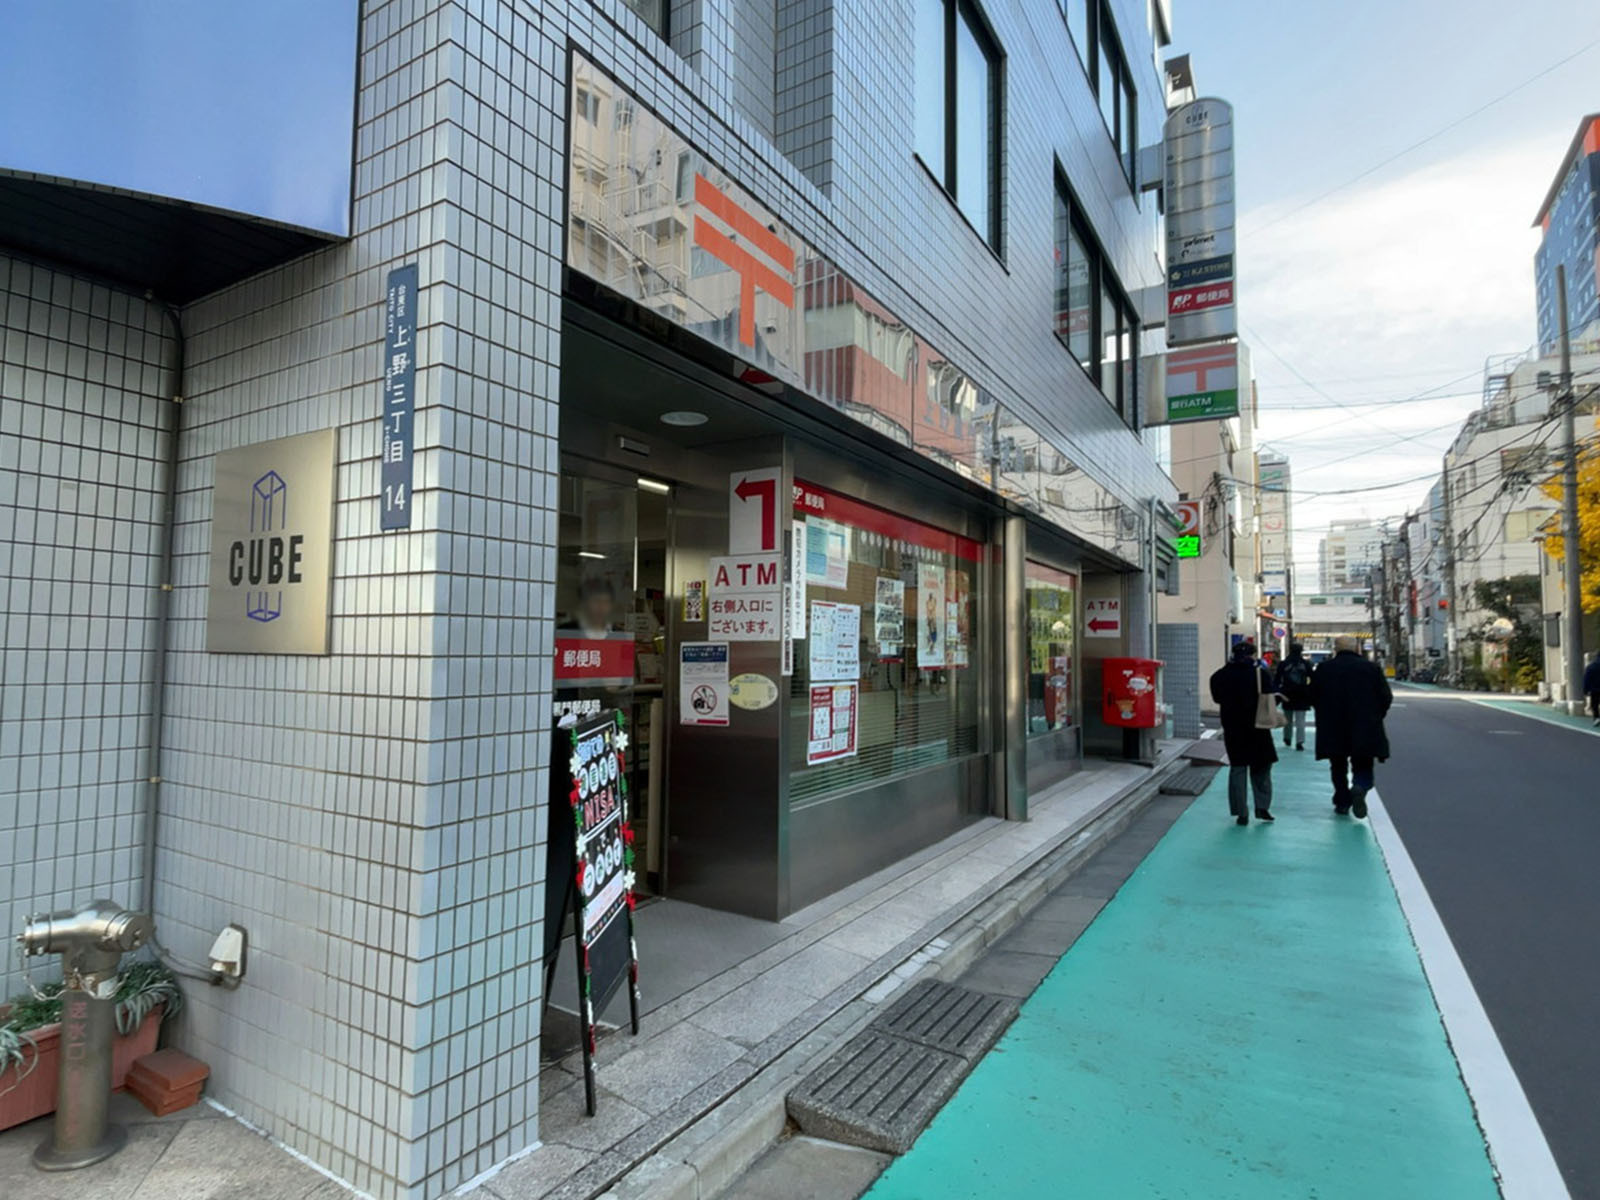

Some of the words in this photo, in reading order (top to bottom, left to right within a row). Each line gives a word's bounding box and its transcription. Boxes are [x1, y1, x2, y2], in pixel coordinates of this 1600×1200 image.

[391, 325, 407, 462] 上野三丁目
[385, 483, 405, 511] 14
[229, 534, 304, 587] CUBE
[714, 562, 777, 587] ATM
[711, 600, 773, 614] 右側入口に
[1087, 601, 1118, 610] ATM
[711, 620, 774, 634] ございます。
[563, 650, 601, 667] 郵便局
[584, 785, 616, 831] NISA
